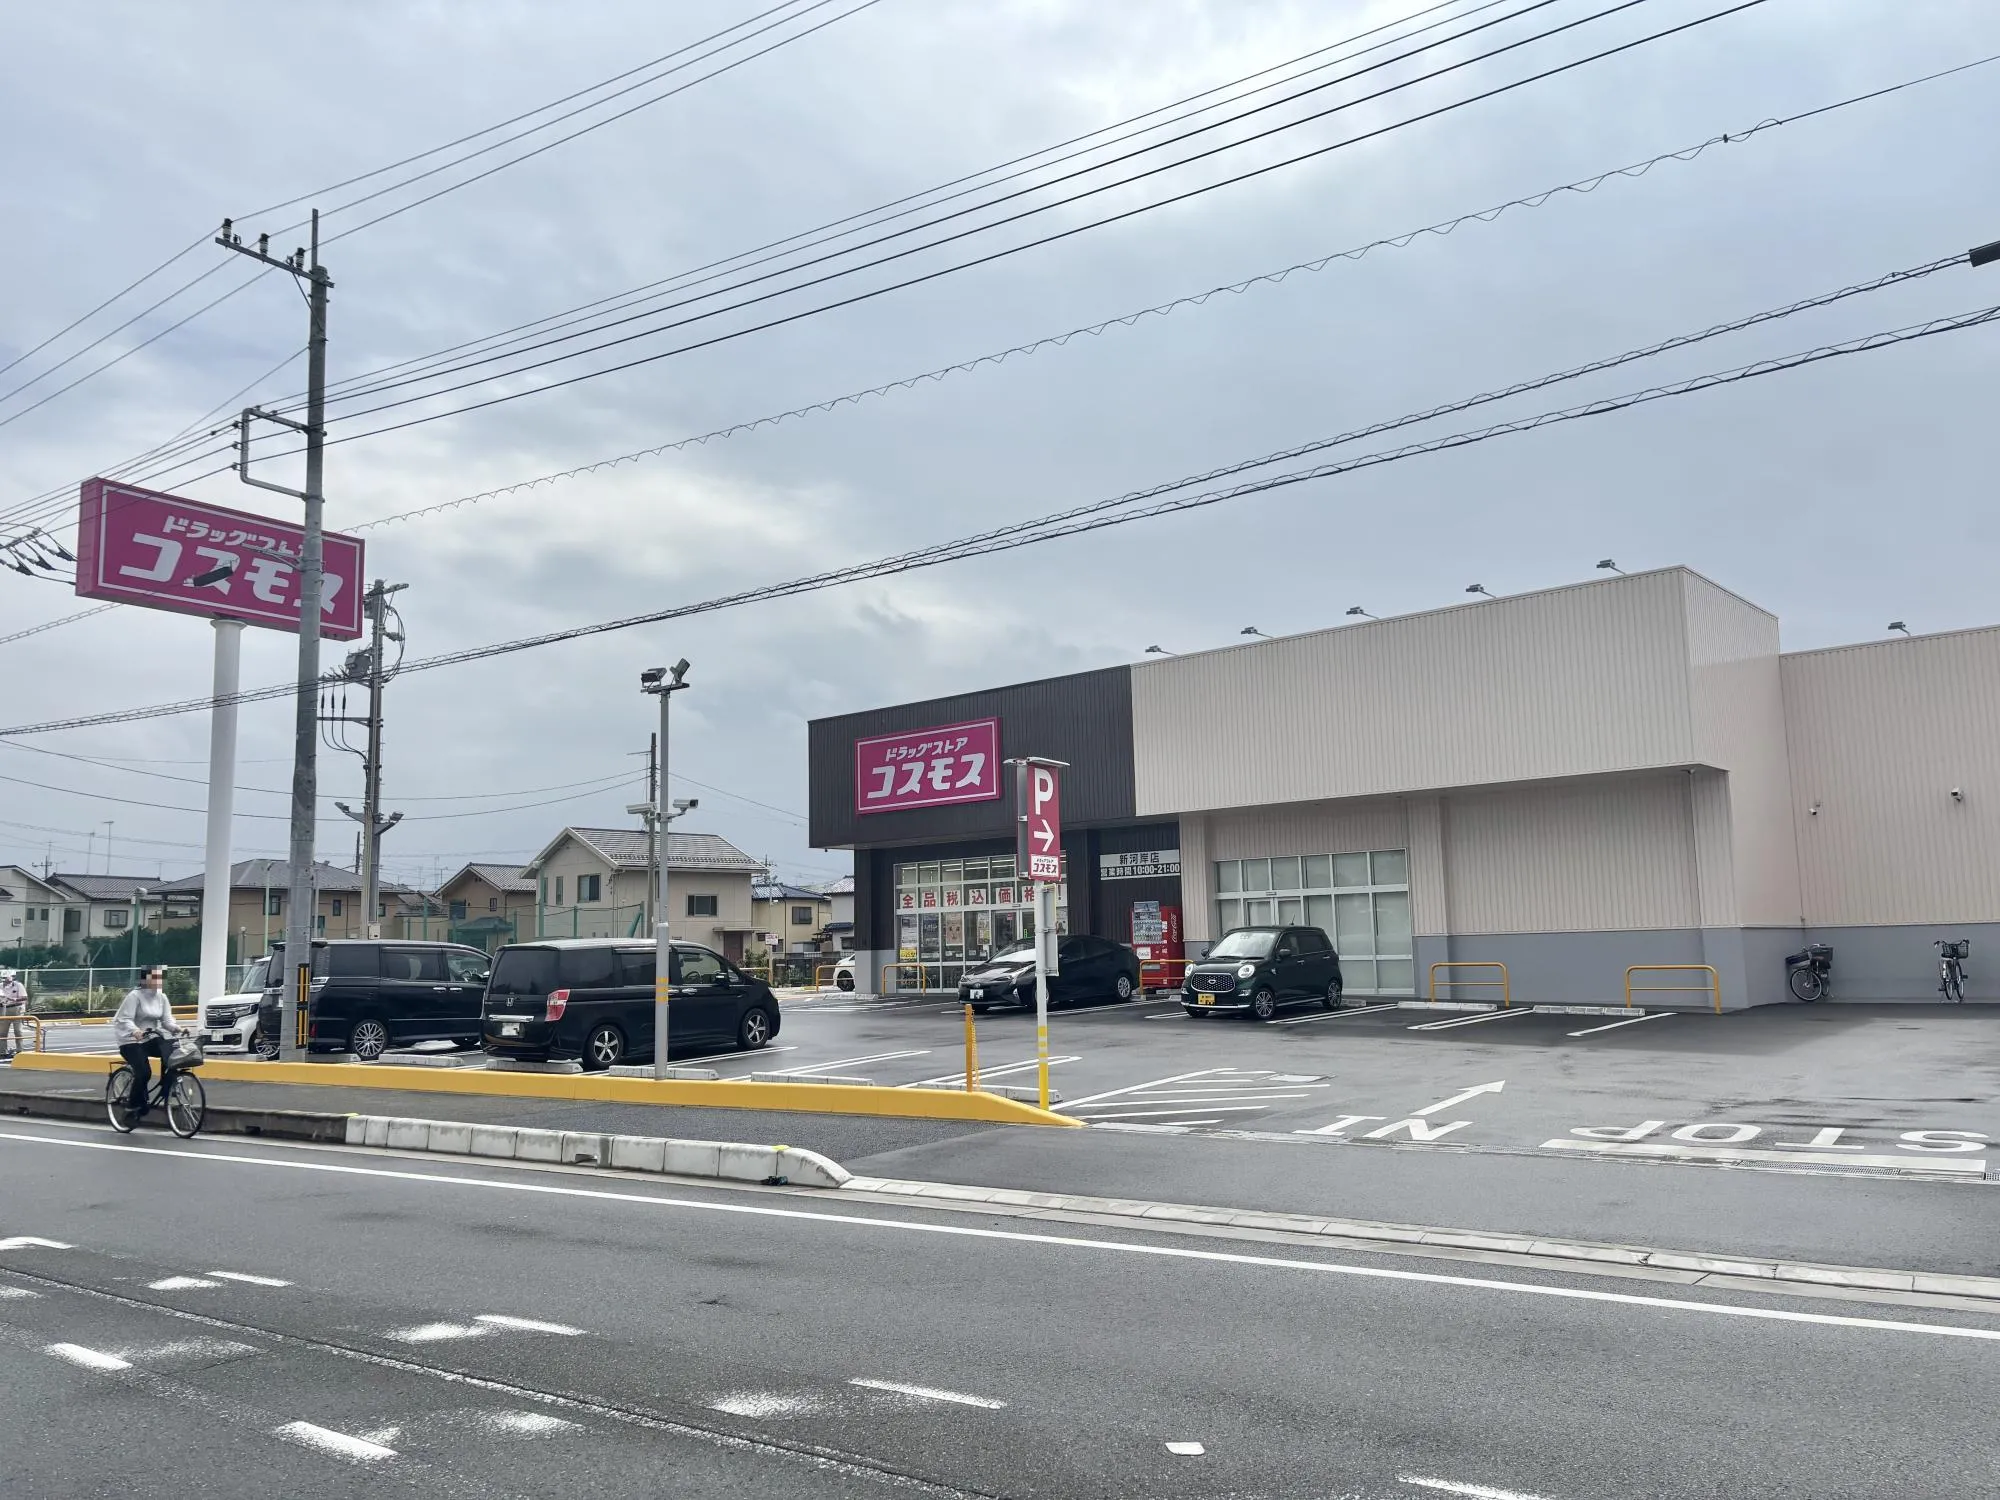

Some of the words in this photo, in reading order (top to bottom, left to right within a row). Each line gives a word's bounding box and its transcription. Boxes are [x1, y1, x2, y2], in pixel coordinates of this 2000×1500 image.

[162, 515, 304, 557] ドラッグスト
[885, 736, 968, 761] ドラッグストア
[867, 753, 985, 799] コスモス
[1034, 768, 1054, 815] P
[1033, 863, 1057, 873] コスモス
[1119, 852, 1160, 865] 新河岸店
[1292, 1114, 1474, 1141] IN
[1569, 1120, 1989, 1153] STOP
